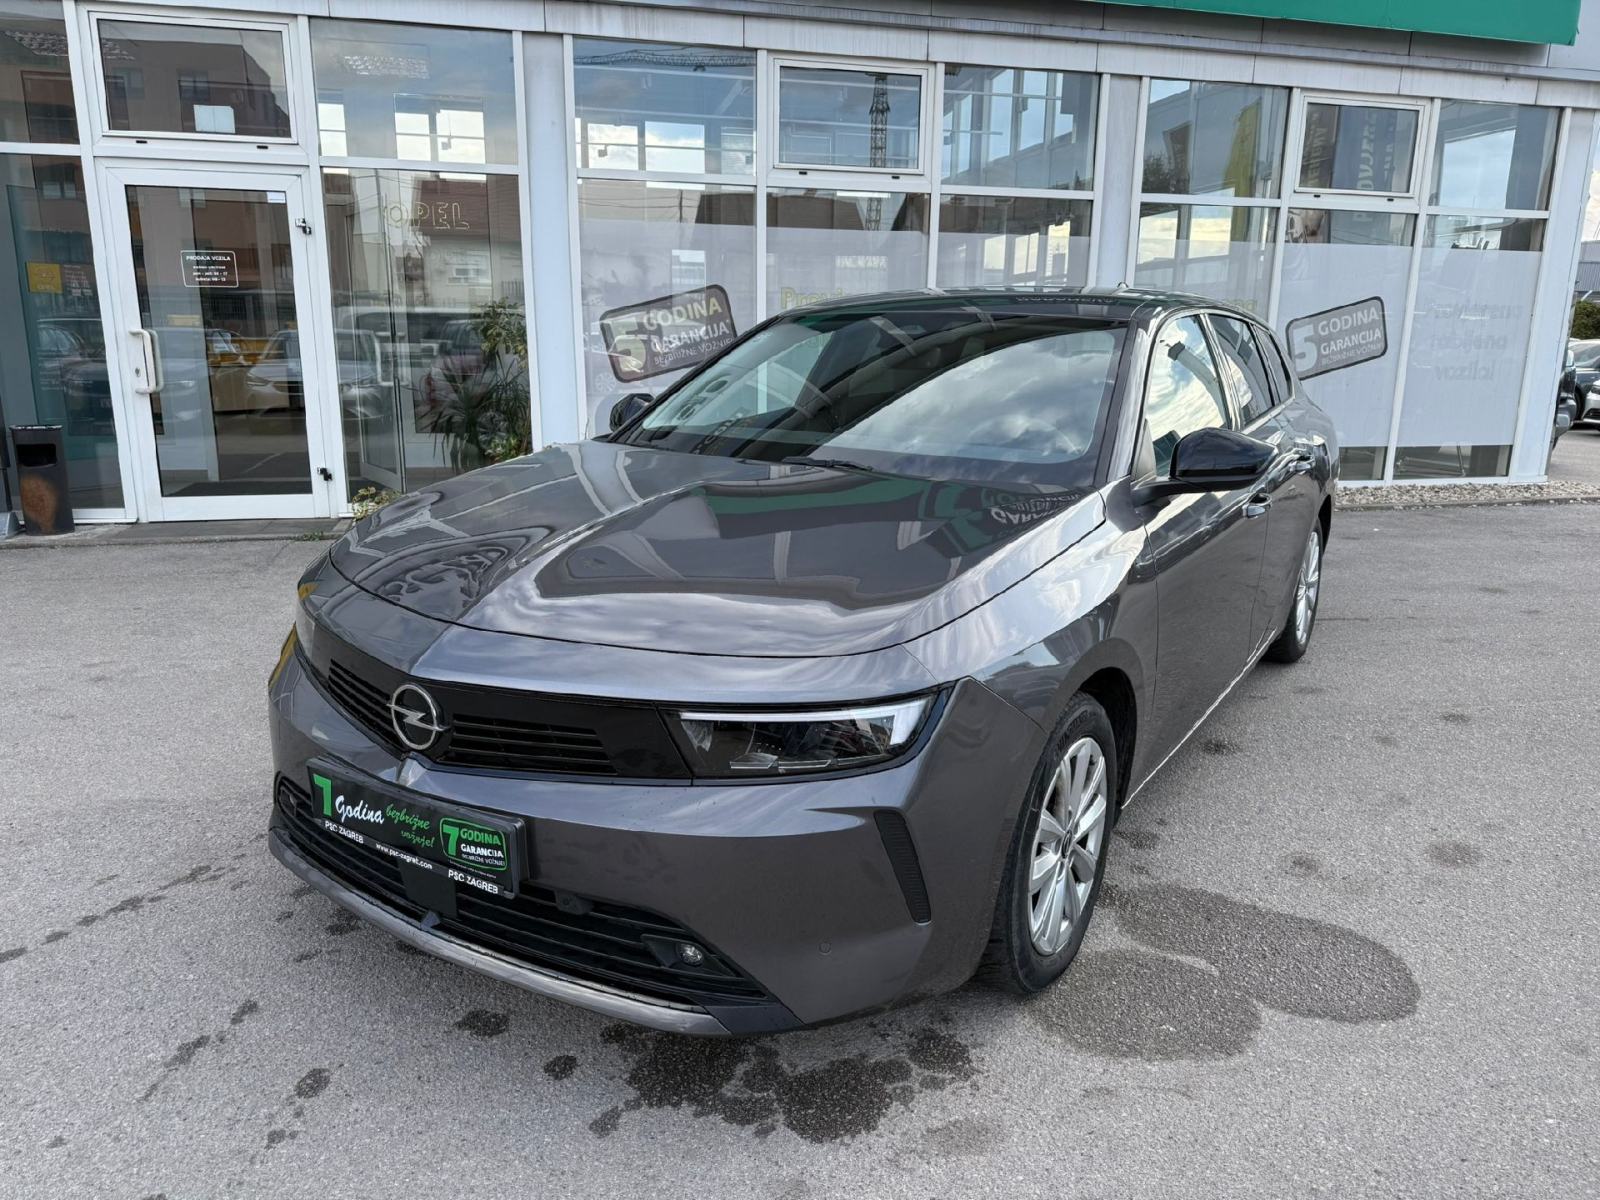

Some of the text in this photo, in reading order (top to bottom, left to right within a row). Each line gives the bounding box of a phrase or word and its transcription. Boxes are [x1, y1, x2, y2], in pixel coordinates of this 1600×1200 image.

[385, 201, 470, 229] OPEL
[643, 297, 722, 330] GODINA
[1318, 307, 1378, 336] GODINA
[611, 316, 646, 373] 5
[1293, 324, 1318, 372] 5
[1321, 328, 1382, 355] GARANCIJA
[335, 795, 385, 825] Godina
[325, 820, 364, 844] PSC ZAGREB
[443, 824, 459, 856] 7
[460, 828, 501, 846] GODINA
[460, 843, 504, 858] GARANCIJA
[448, 869, 464, 882] PSC
[466, 876, 499, 894] ZAGREB
